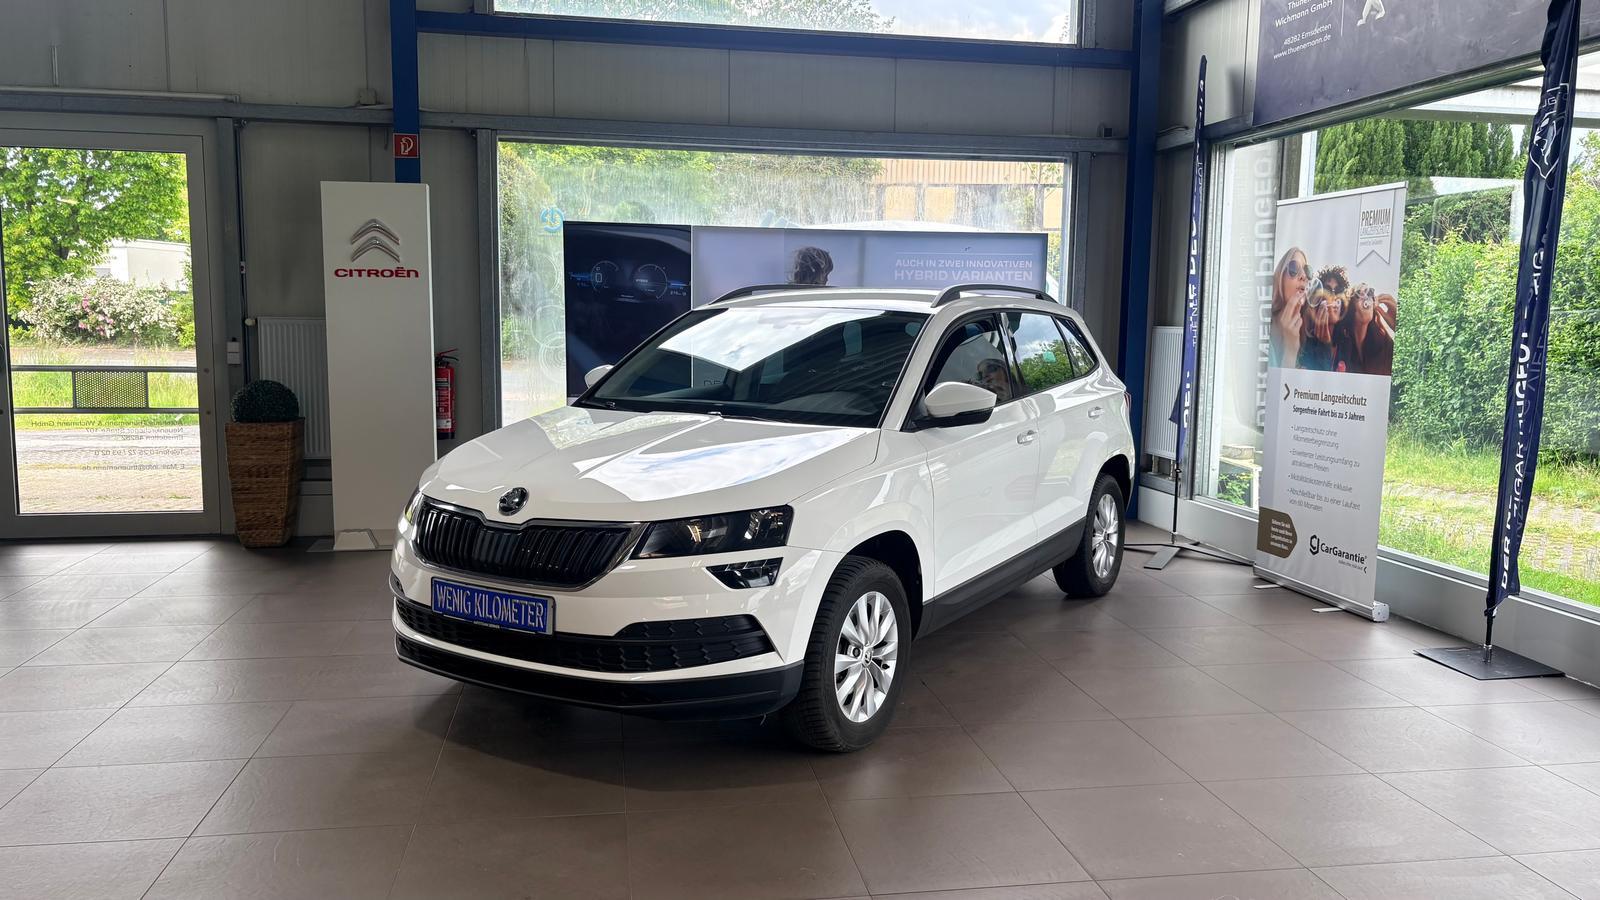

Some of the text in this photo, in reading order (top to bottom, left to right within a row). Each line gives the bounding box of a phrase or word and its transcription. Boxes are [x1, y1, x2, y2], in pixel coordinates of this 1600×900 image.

[1275, 0, 1333, 27] Wichmann GmbH
[1284, 23, 1331, 44] 48282 Emsdetten
[1273, 33, 1331, 60] www.thuenemann.de
[1361, 208, 1391, 226] PREMIUM
[895, 259, 1033, 268] AUCH IN ZWEI INNOVATIVEN
[894, 269, 1033, 281] HYBRID VARIANTEN
[1294, 388, 1367, 406] Premium Langzeitschutz
[1293, 404, 1317, 416] Sorgenfreie
[1318, 407, 1330, 417] Fahrt
[1344, 411, 1348, 420] 5
[1348, 411, 1365, 421] Jahren
[1320, 542, 1365, 565] CarGarantie
[436, 583, 544, 629] WENIG KILOMETER
